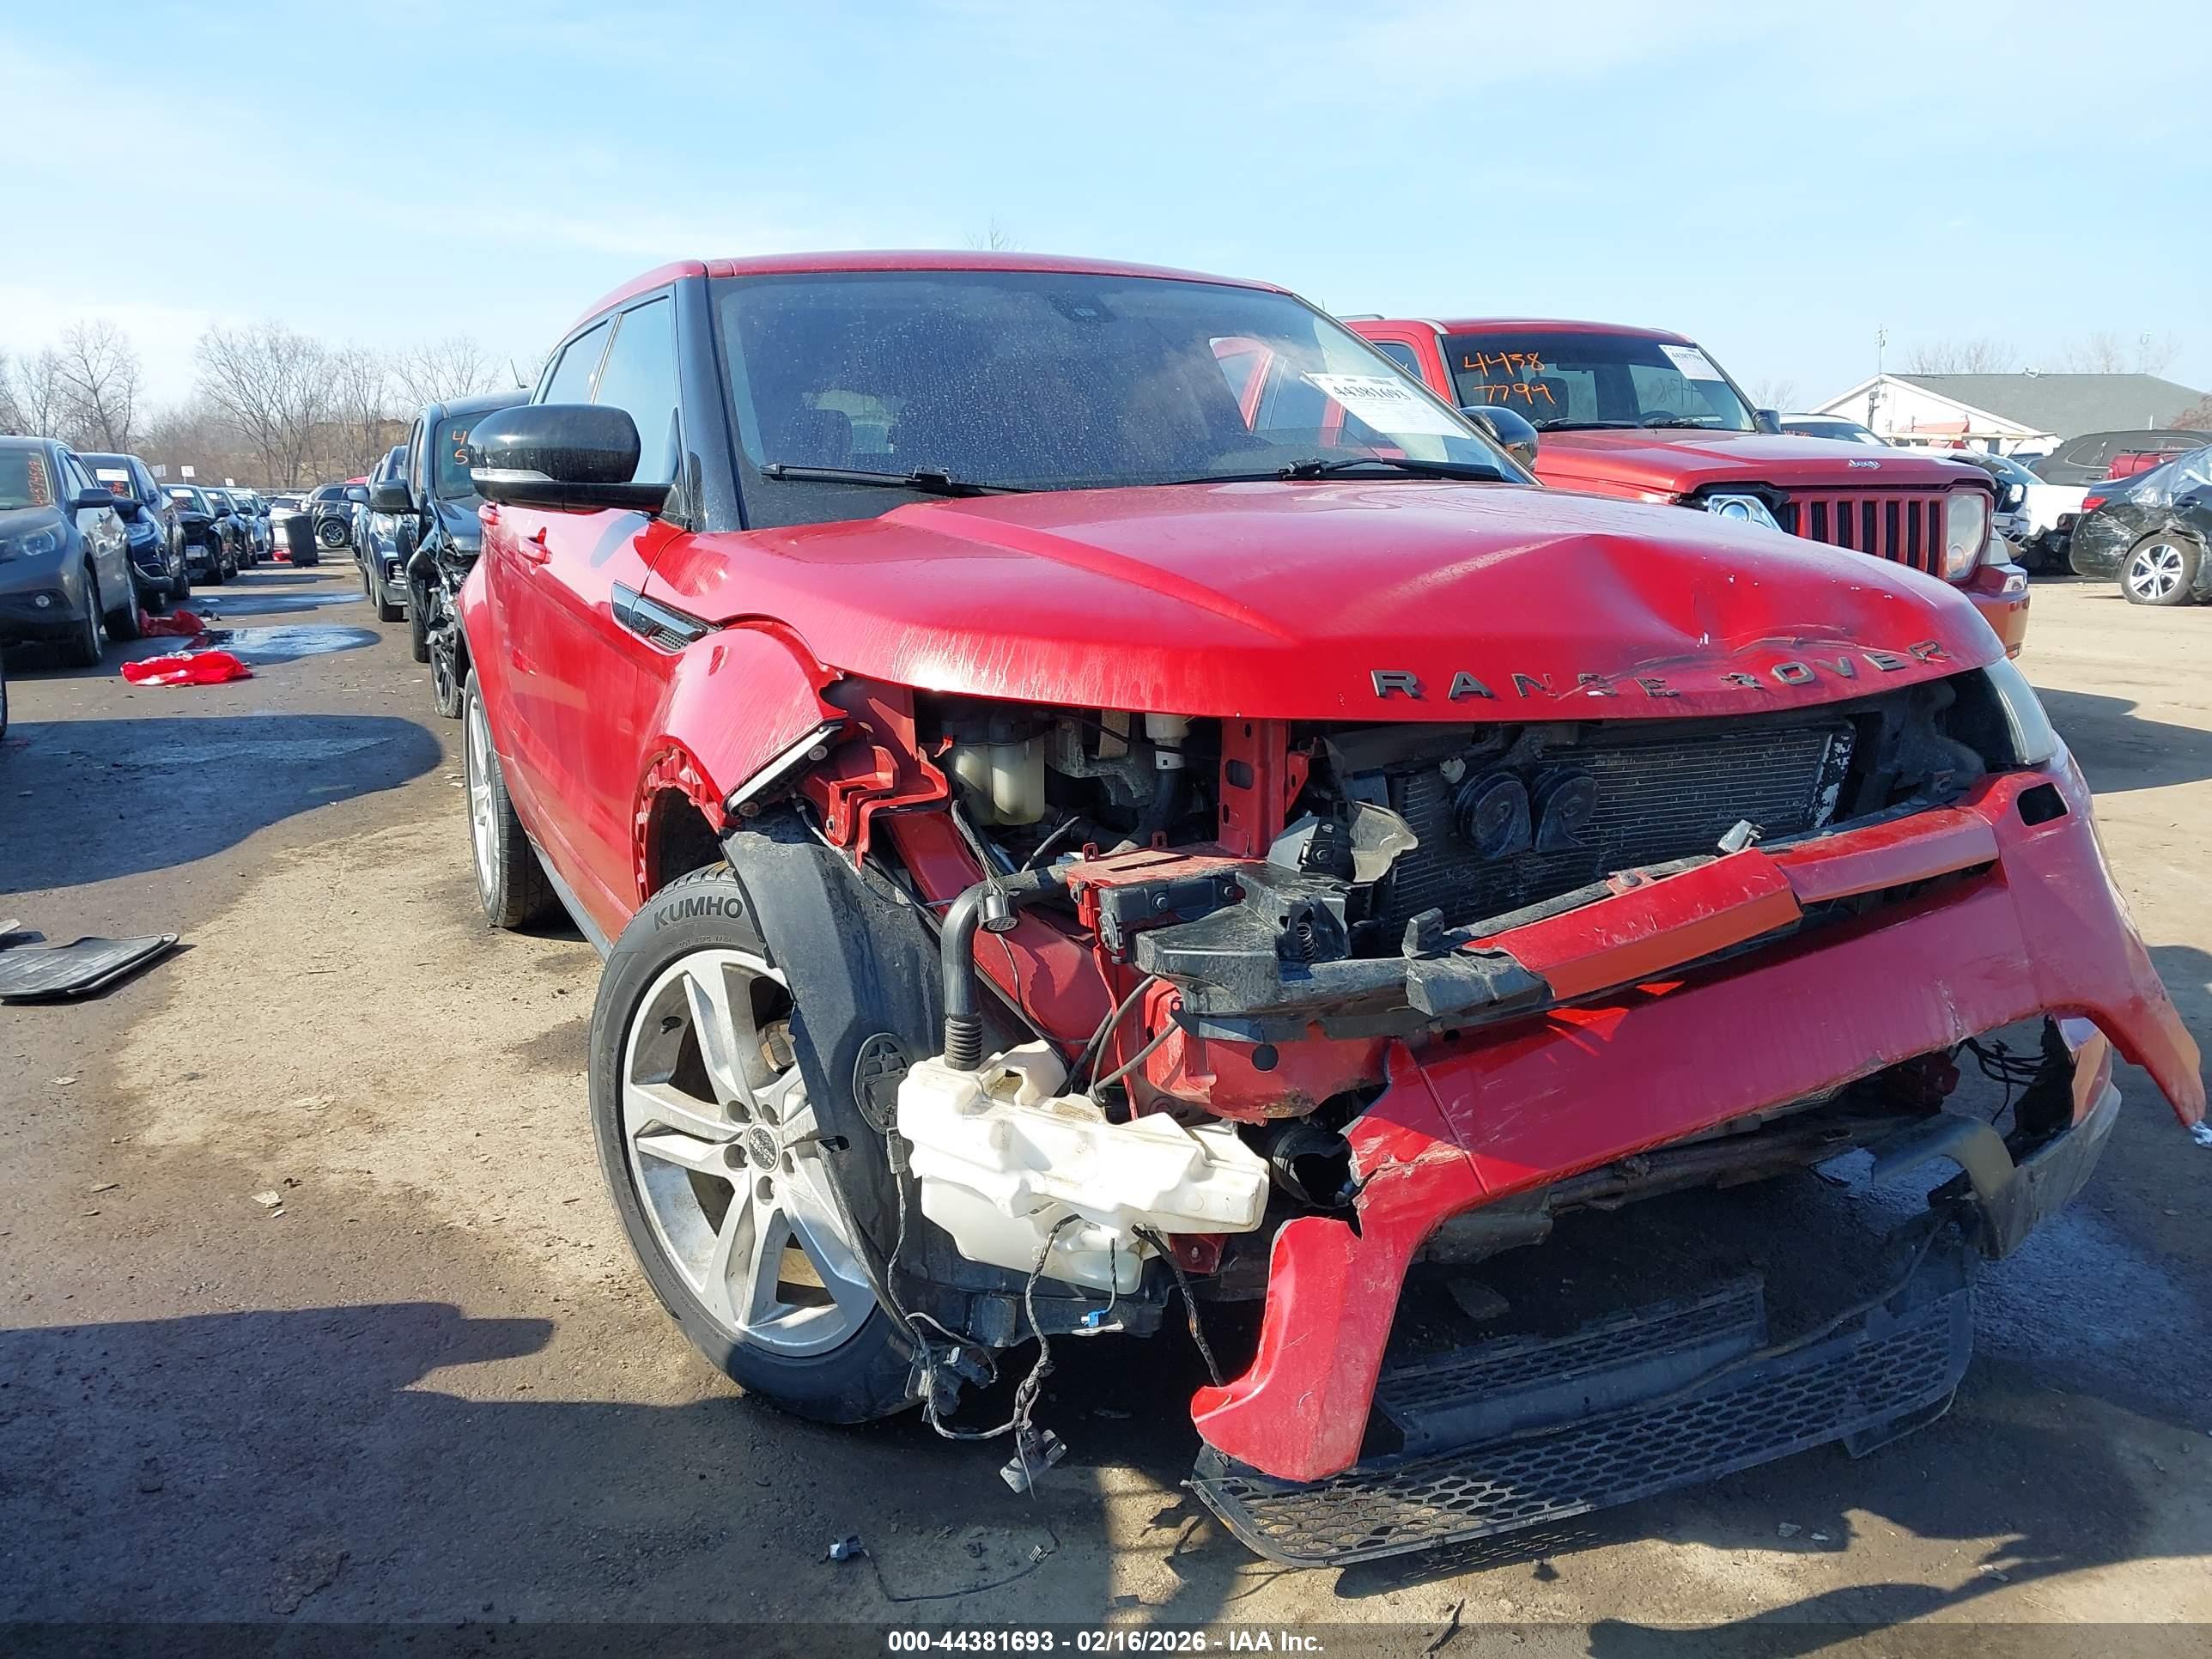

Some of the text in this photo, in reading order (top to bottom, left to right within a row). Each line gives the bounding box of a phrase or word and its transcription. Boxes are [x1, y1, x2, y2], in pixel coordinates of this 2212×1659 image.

[1464, 351, 1545, 377] 4438
[1473, 383, 1556, 404] 7794
[1848, 459, 1881, 470] Jeep
[653, 896, 744, 931] KUMHO
